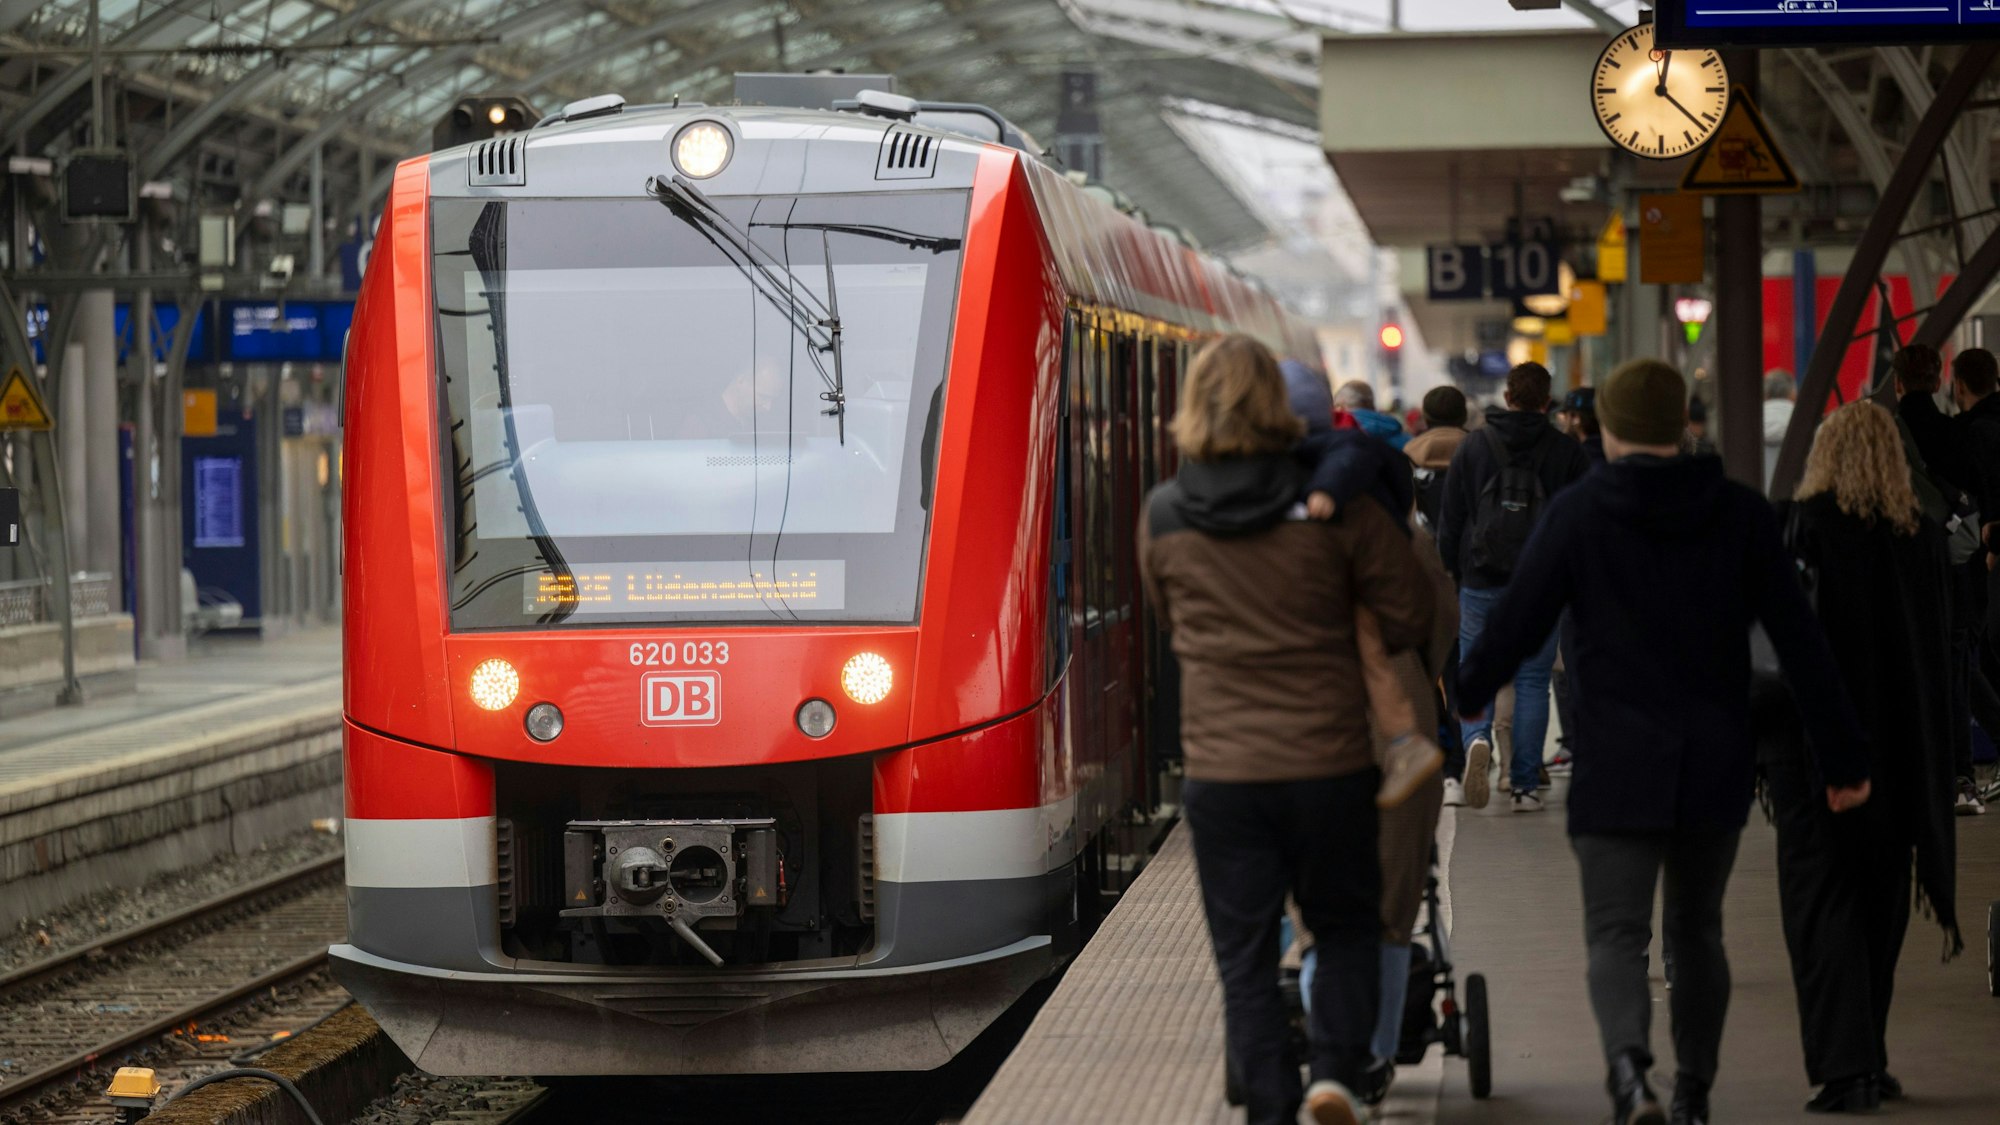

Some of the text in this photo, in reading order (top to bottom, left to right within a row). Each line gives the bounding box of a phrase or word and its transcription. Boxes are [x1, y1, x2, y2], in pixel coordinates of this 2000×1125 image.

[1432, 247, 1466, 291] B
[1498, 243, 1549, 289] 10
[629, 641, 730, 666] 620 033
[652, 680, 711, 717] DB
